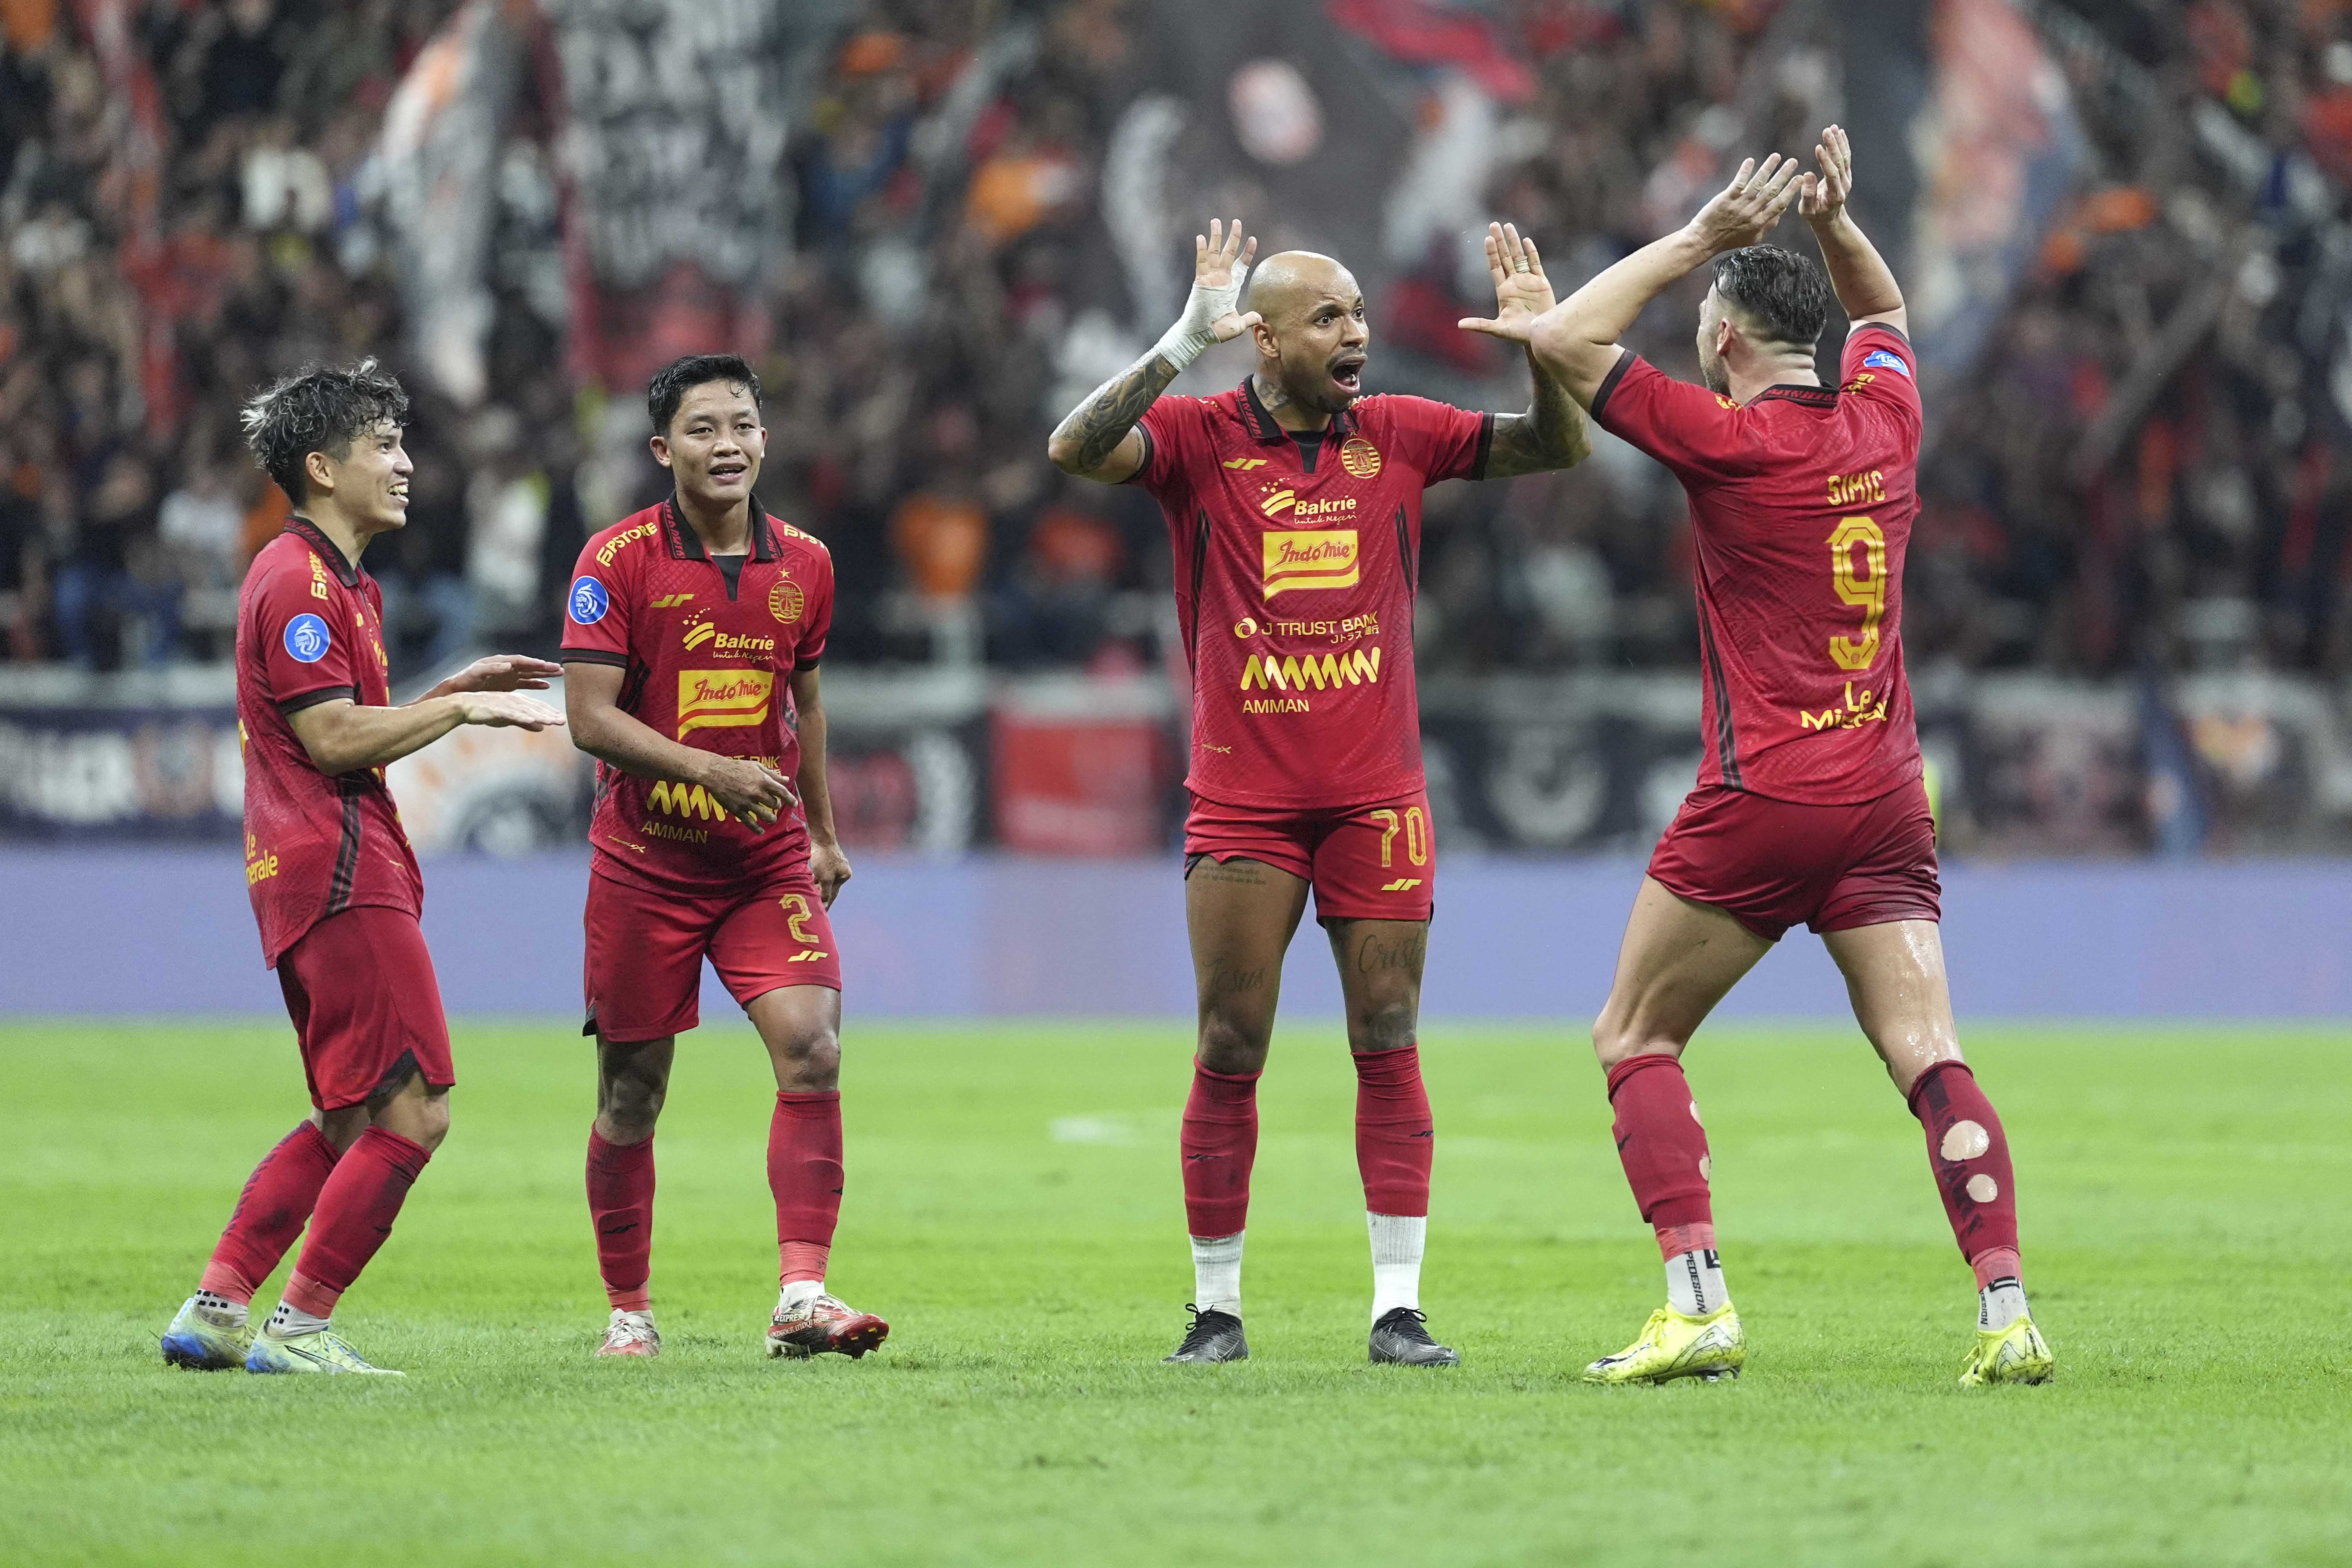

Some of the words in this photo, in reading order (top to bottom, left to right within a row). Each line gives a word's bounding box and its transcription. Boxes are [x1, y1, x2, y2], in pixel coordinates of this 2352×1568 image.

[1294, 495, 1357, 515] Bakrie
[1825, 517, 1887, 670] 9
[714, 633, 775, 650] Bakrie
[1261, 622, 1273, 635] J
[1277, 621, 1337, 636] TRUST
[1242, 699, 1310, 713] AMMAN
[247, 830, 256, 861] Le
[641, 820, 708, 844] AMMAN
[1370, 807, 1427, 867] 70
[779, 894, 819, 944] 2
[1684, 1250, 1707, 1314] PEDESIGN
